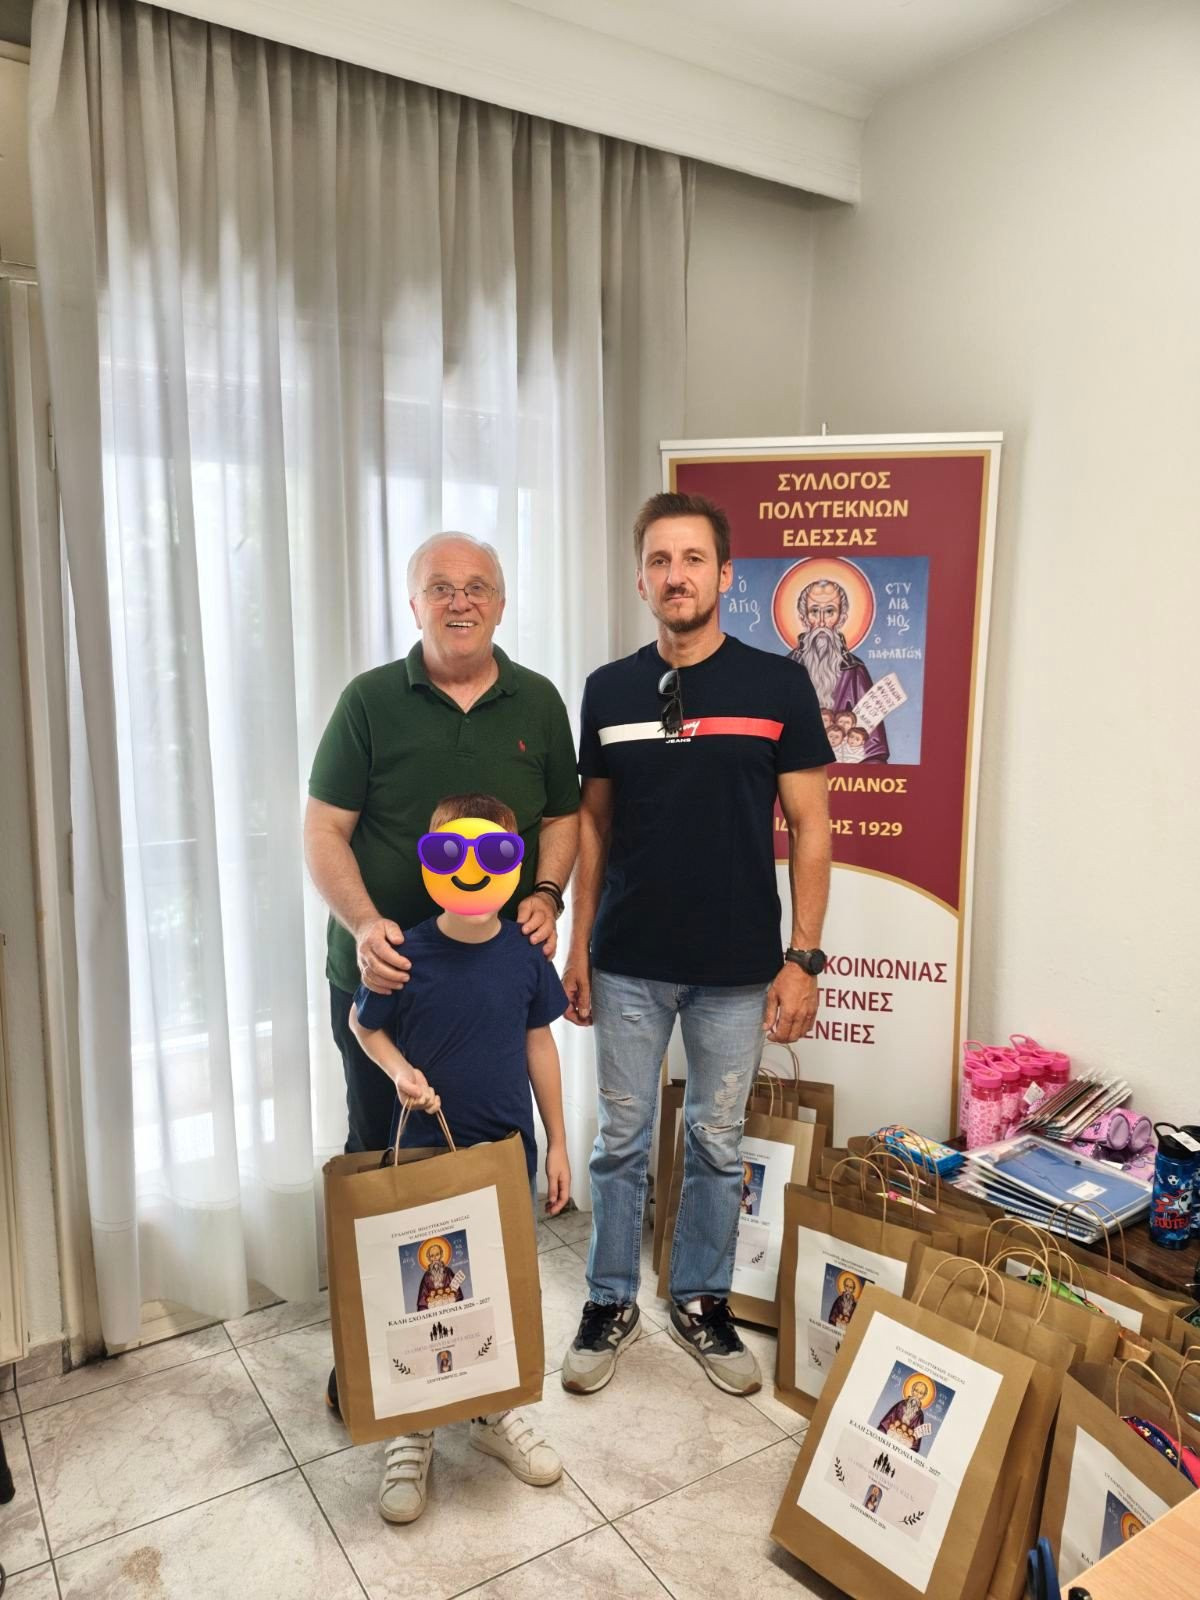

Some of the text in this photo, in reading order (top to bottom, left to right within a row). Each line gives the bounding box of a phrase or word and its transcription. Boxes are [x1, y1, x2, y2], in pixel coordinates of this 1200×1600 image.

[777, 472, 891, 492] ΣΥΛΛΟΓΟΣ
[759, 499, 909, 520] ΠΟΛΥΤΕΚΝΩΝ
[783, 528, 878, 548] ΕΔΕΣΣΑΣ
[827, 777, 907, 793] ΥΛΙΑΝΟΣ
[858, 821, 903, 836] 1929
[824, 955, 947, 984] ΚΟΙΝΩΝΙΑΣ
[817, 987, 893, 1012] ΤΕΚΝΕΣ
[804, 1020, 875, 1044] ΝΕΙΕΣ
[388, 1318, 408, 1327] ΚΑΛΗ
[849, 1419, 866, 1433] ΚΑΛΗ
